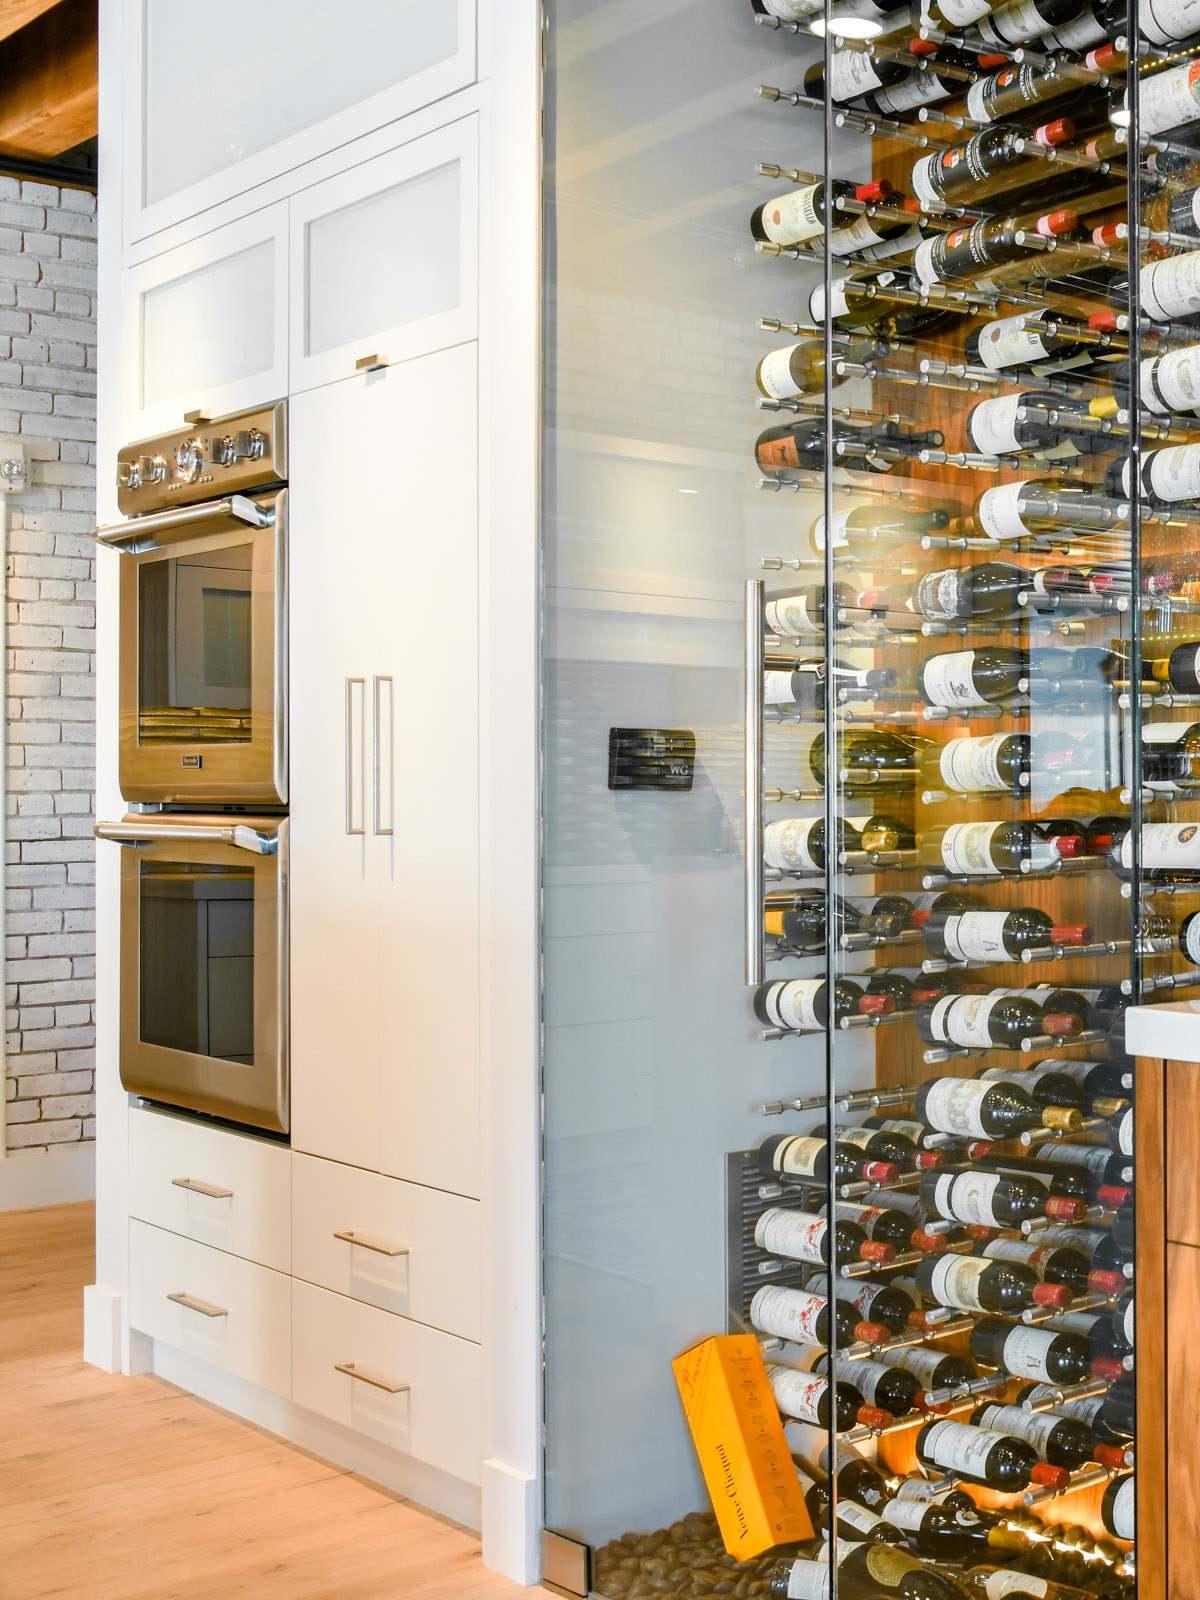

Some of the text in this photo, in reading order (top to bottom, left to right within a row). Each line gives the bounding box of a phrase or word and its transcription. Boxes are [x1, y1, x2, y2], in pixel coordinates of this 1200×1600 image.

[670, 765, 689, 776] WG
[715, 1442, 750, 1541] Veuve Clicquot
